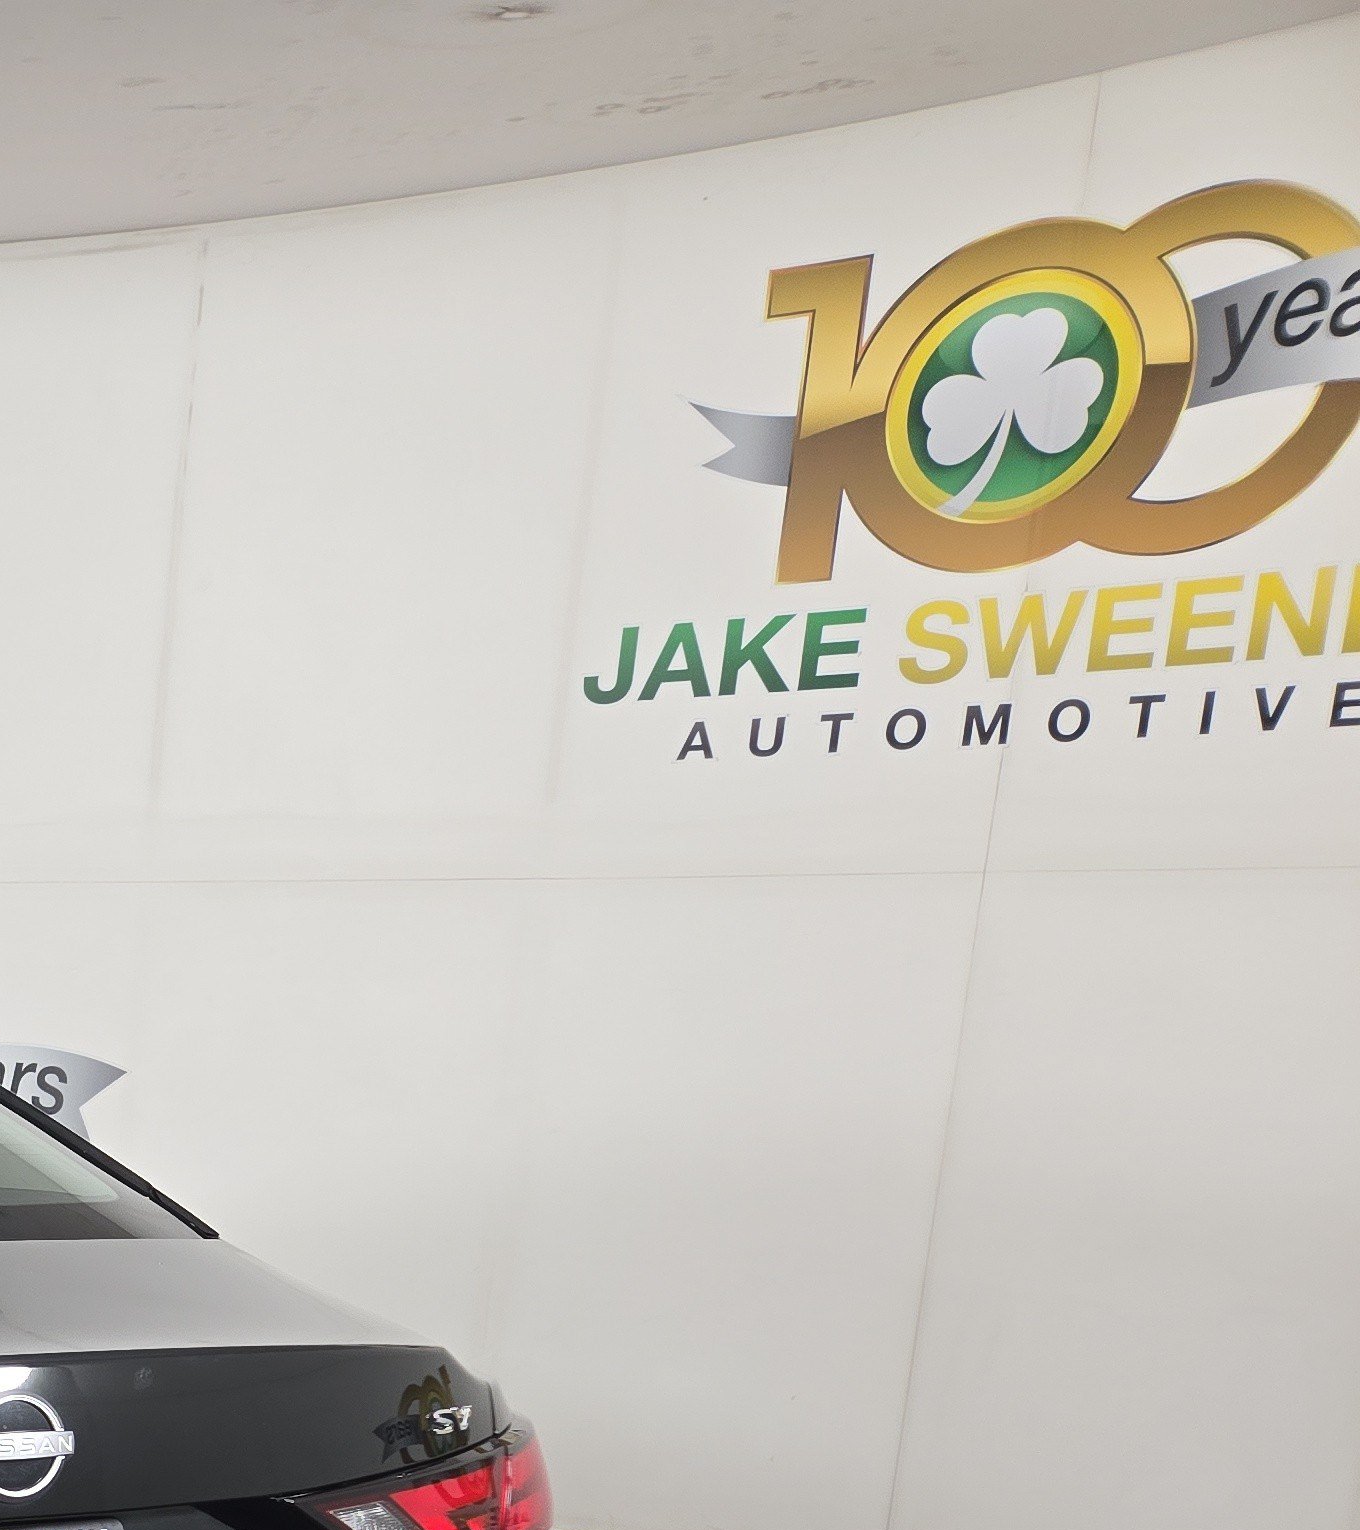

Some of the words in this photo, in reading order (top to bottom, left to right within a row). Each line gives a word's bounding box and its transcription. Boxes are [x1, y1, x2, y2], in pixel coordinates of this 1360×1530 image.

[583, 608, 868, 704] JAKE
[897, 562, 1360, 684] SWEEN
[676, 681, 1360, 761] AUTOMOTIVE
